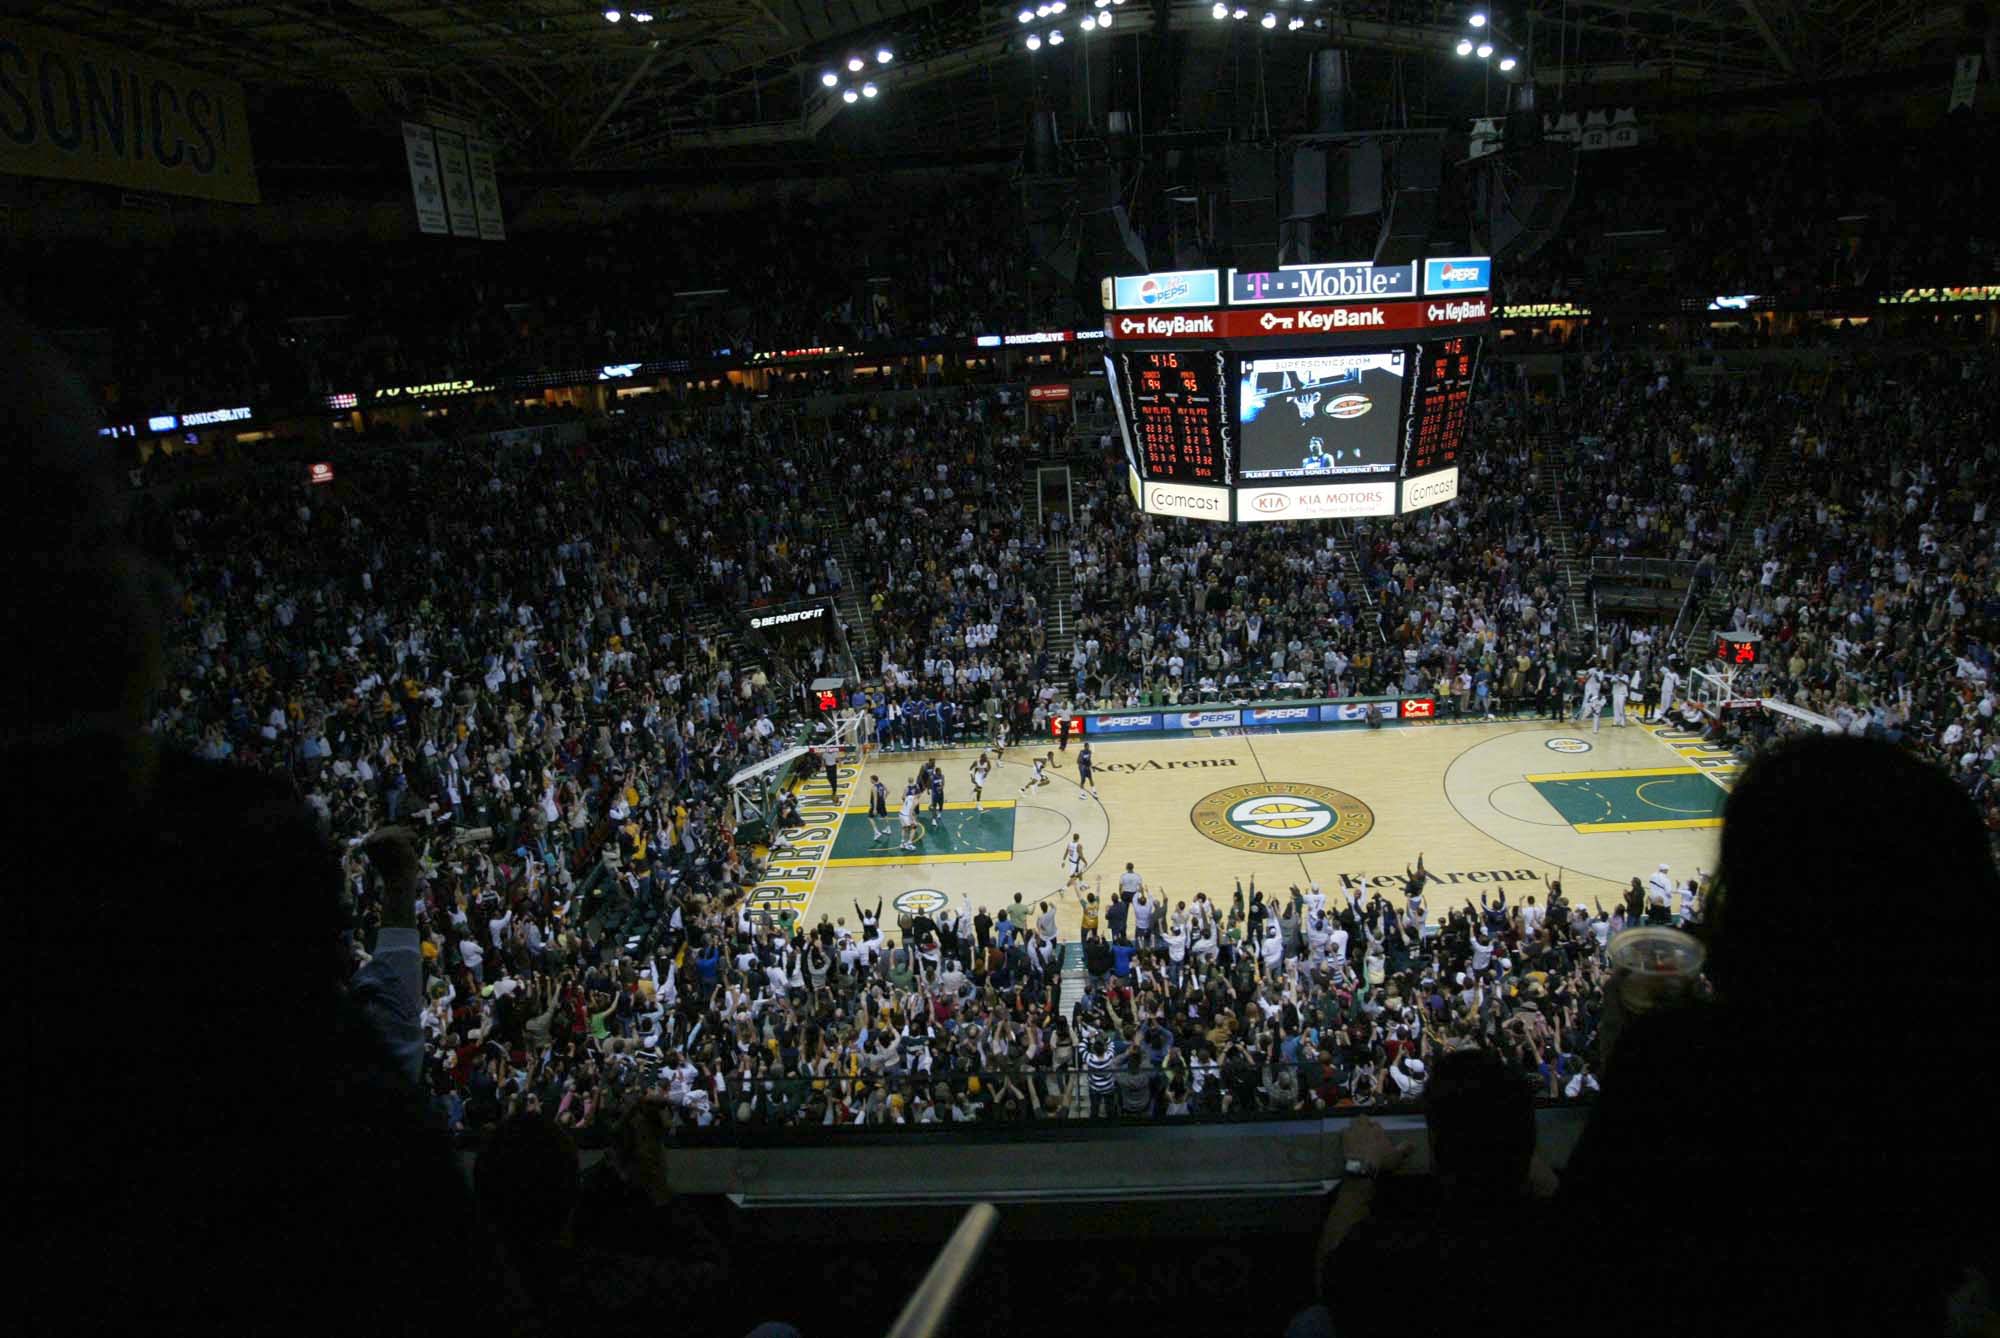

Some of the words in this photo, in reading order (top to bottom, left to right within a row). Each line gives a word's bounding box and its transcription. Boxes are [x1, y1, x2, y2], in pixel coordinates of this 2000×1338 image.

[1451, 267, 1480, 281] PEPSI
[1157, 284, 1188, 303] PEPSI
[1298, 307, 1385, 331] KeyBank
[1445, 301, 1486, 322] KeyBank
[1147, 315, 1214, 337] KeyBank
[1148, 379, 1161, 390] 94
[1183, 379, 1198, 391] 95
[1215, 350, 1228, 424] SEATTLE
[1221, 426, 1232, 485] CENTER
[1299, 494, 1321, 505] KIA
[1326, 491, 1383, 504] MOTORS
[1413, 477, 1455, 502] comcast
[1155, 488, 1219, 511] comcast
[1258, 496, 1284, 509] KIA
[762, 617, 776, 627] BE
[776, 612, 800, 624] PART
[800, 609, 814, 620] OF
[814, 608, 825, 618] IT
[1200, 713, 1235, 724] PEPSI
[1266, 708, 1308, 719] PEPSI
[1357, 706, 1393, 716] PSI
[1111, 715, 1152, 727] PEPSI
[1210, 785, 1336, 806] SEATTLE
[1203, 812, 1365, 851] SUPERSONICS
